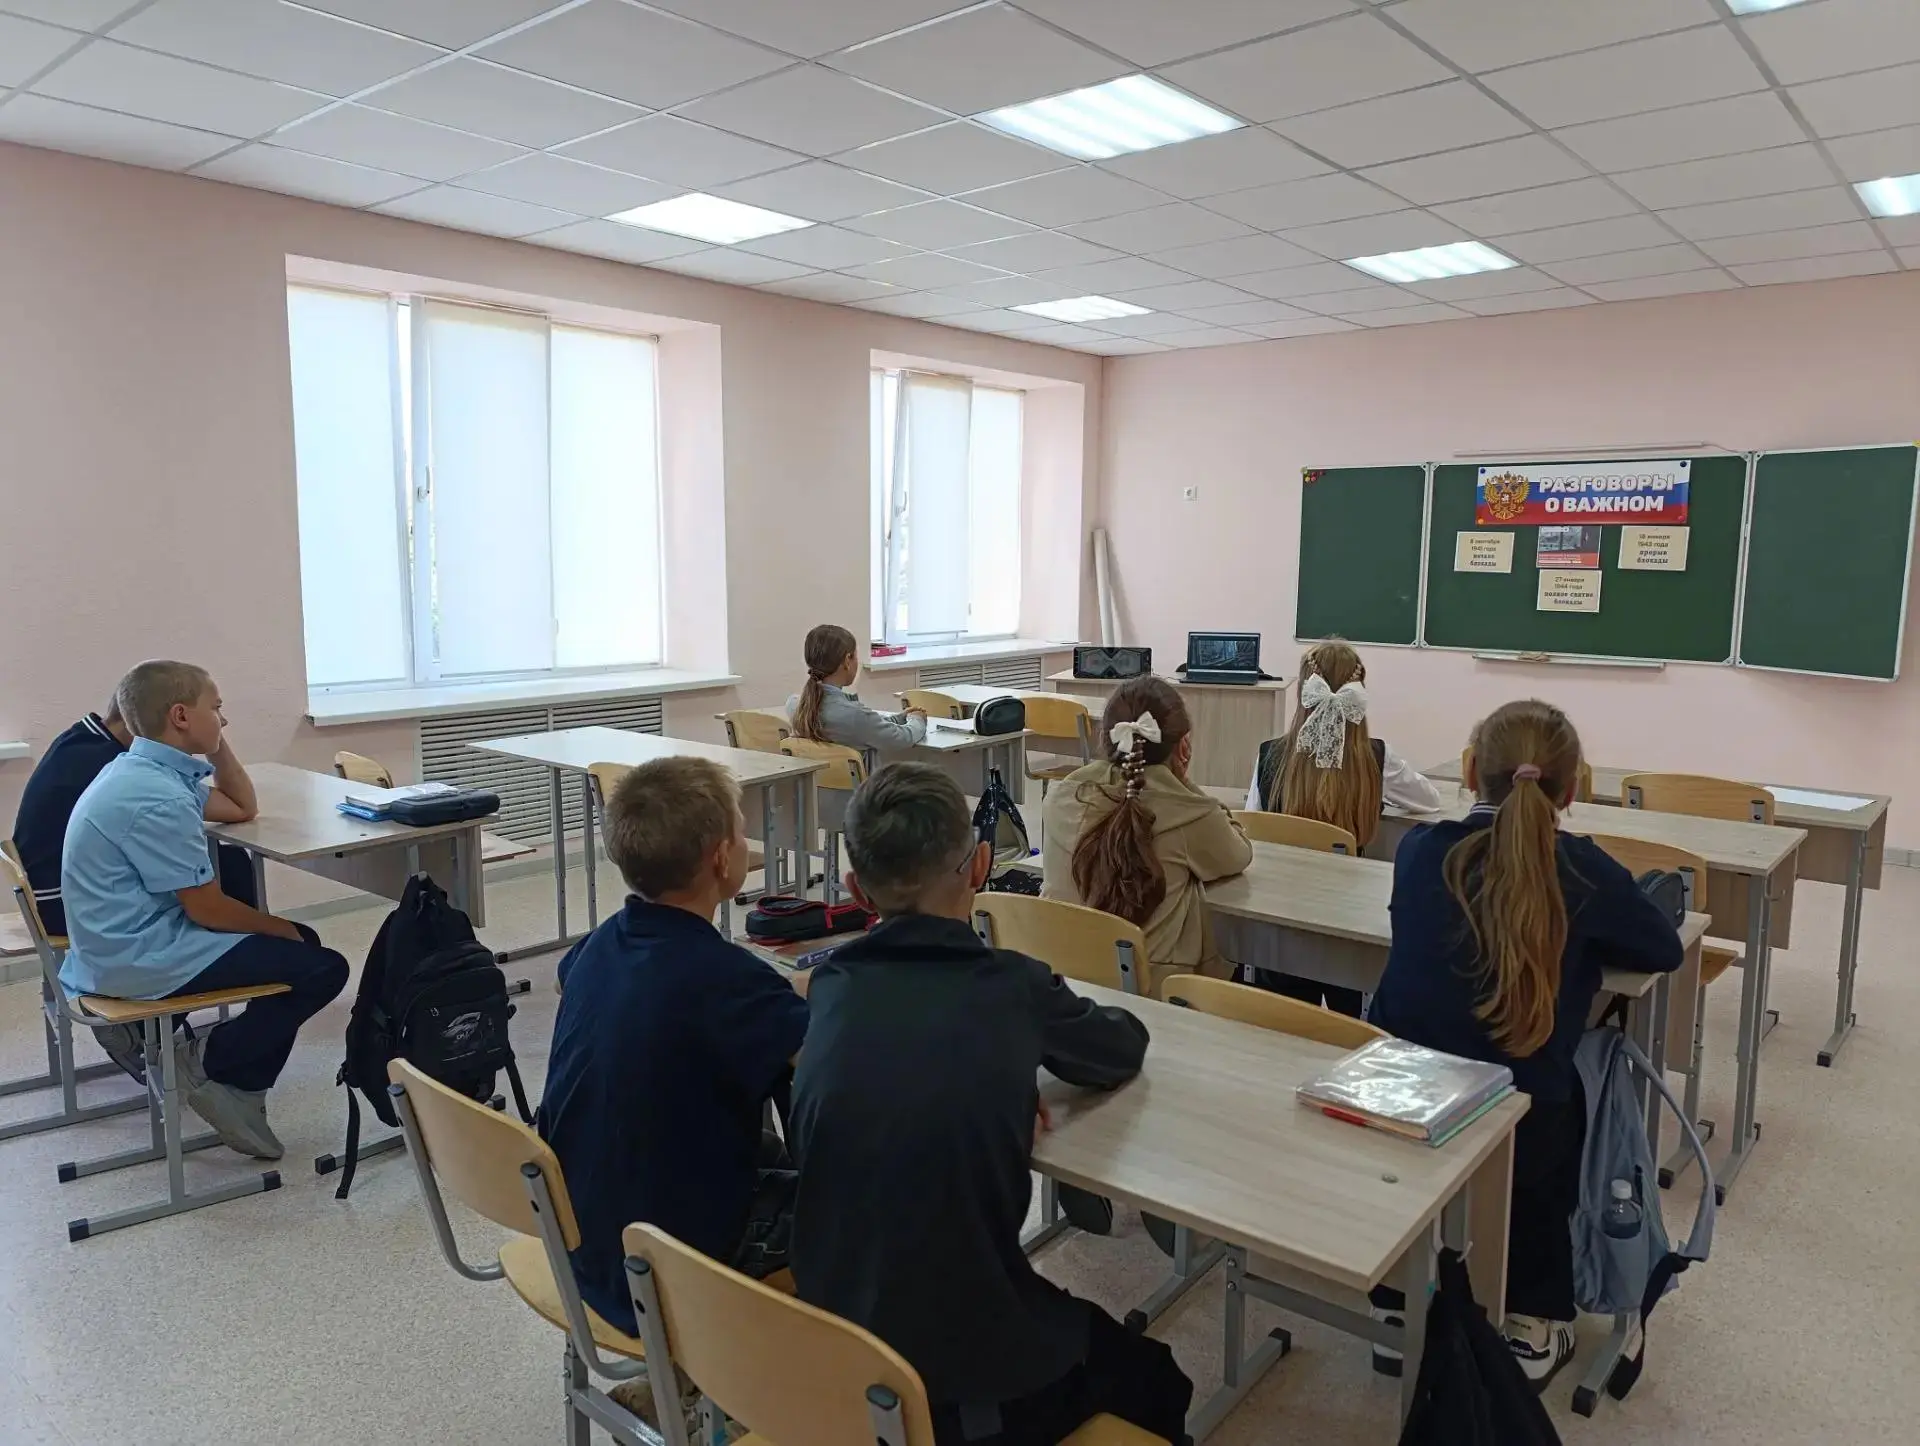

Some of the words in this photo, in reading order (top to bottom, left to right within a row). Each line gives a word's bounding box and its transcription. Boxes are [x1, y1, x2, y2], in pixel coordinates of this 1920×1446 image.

[1539, 473, 1676, 493] РАЗГОВОРЫ
[1545, 497, 1560, 513] О
[1563, 495, 1664, 513] ВАЖНОМ
